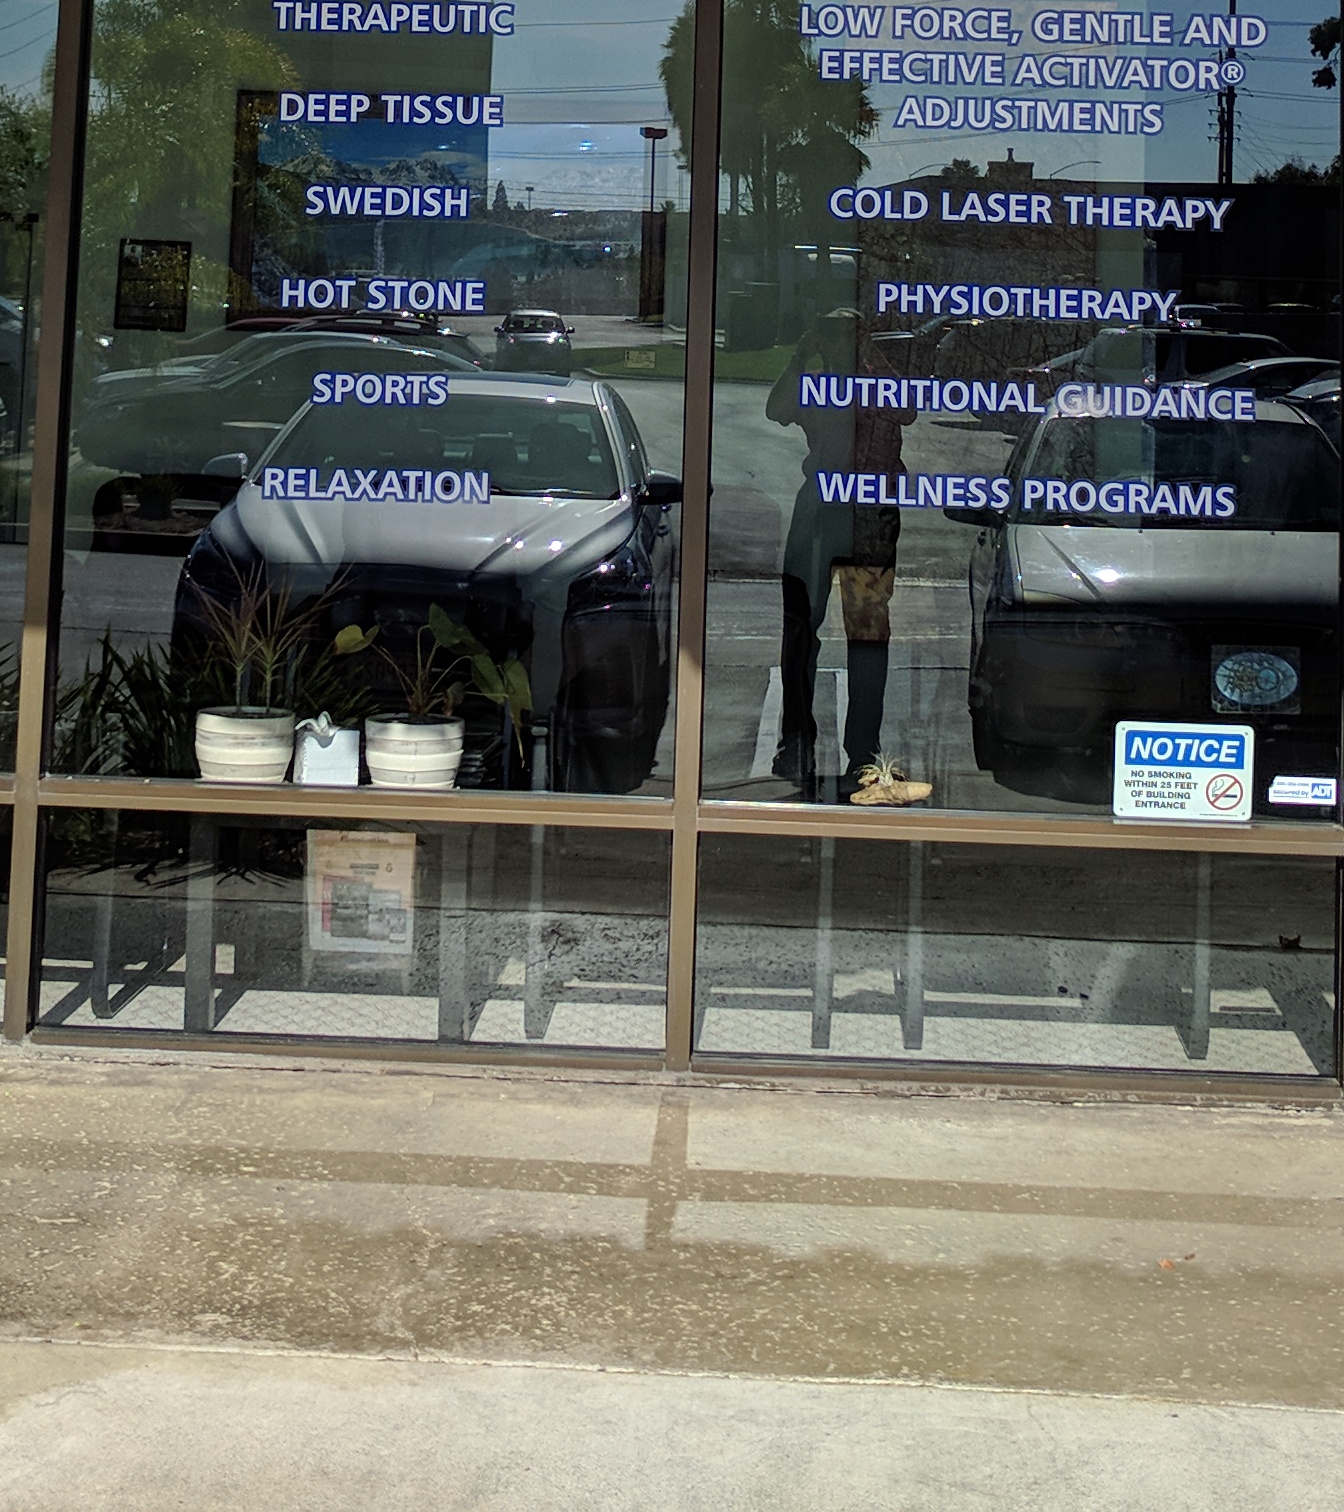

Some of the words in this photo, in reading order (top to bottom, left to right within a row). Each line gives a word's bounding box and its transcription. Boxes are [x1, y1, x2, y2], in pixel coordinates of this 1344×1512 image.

[273, 0, 515, 36] THERAPEUTIC
[799, 3, 886, 39] LOW
[892, 5, 1021, 47] FORCE,
[1032, 9, 1173, 46] GENTLE
[1183, 12, 1268, 49] AND
[819, 48, 1004, 86] EFFECTIVE
[278, 92, 371, 126] DEEP
[381, 93, 505, 129] TISSUE
[894, 94, 1165, 136] ADJUSTMENTS
[304, 185, 470, 219] SWEDISH
[828, 188, 930, 223] COLD
[940, 190, 1054, 226] LASER
[1062, 193, 1234, 233] THERAPY
[280, 277, 356, 311] HOT
[365, 279, 486, 314] STONE
[876, 281, 1182, 323] PHYSIOTHERAPY
[311, 372, 450, 407] SPORTS
[799, 375, 1049, 414] NUTRITIONAL
[1056, 381, 1257, 422] GUIDANCE
[262, 466, 492, 505] RELAXATION
[816, 470, 1012, 510] WELLNESS
[1022, 477, 1236, 519] PROGRAMS
[1130, 736, 1240, 763] NOTICE
[1123, 779, 1158, 789] WITHIN
[1160, 780, 1172, 789] 25
[1174, 781, 1199, 790] FEET
[1130, 769, 1145, 778] NO
[1147, 770, 1192, 780] SMOKING
[1130, 789, 1144, 798] OF
[1146, 790, 1192, 800] BUILDING
[1134, 800, 1187, 810] ENTRANCE
